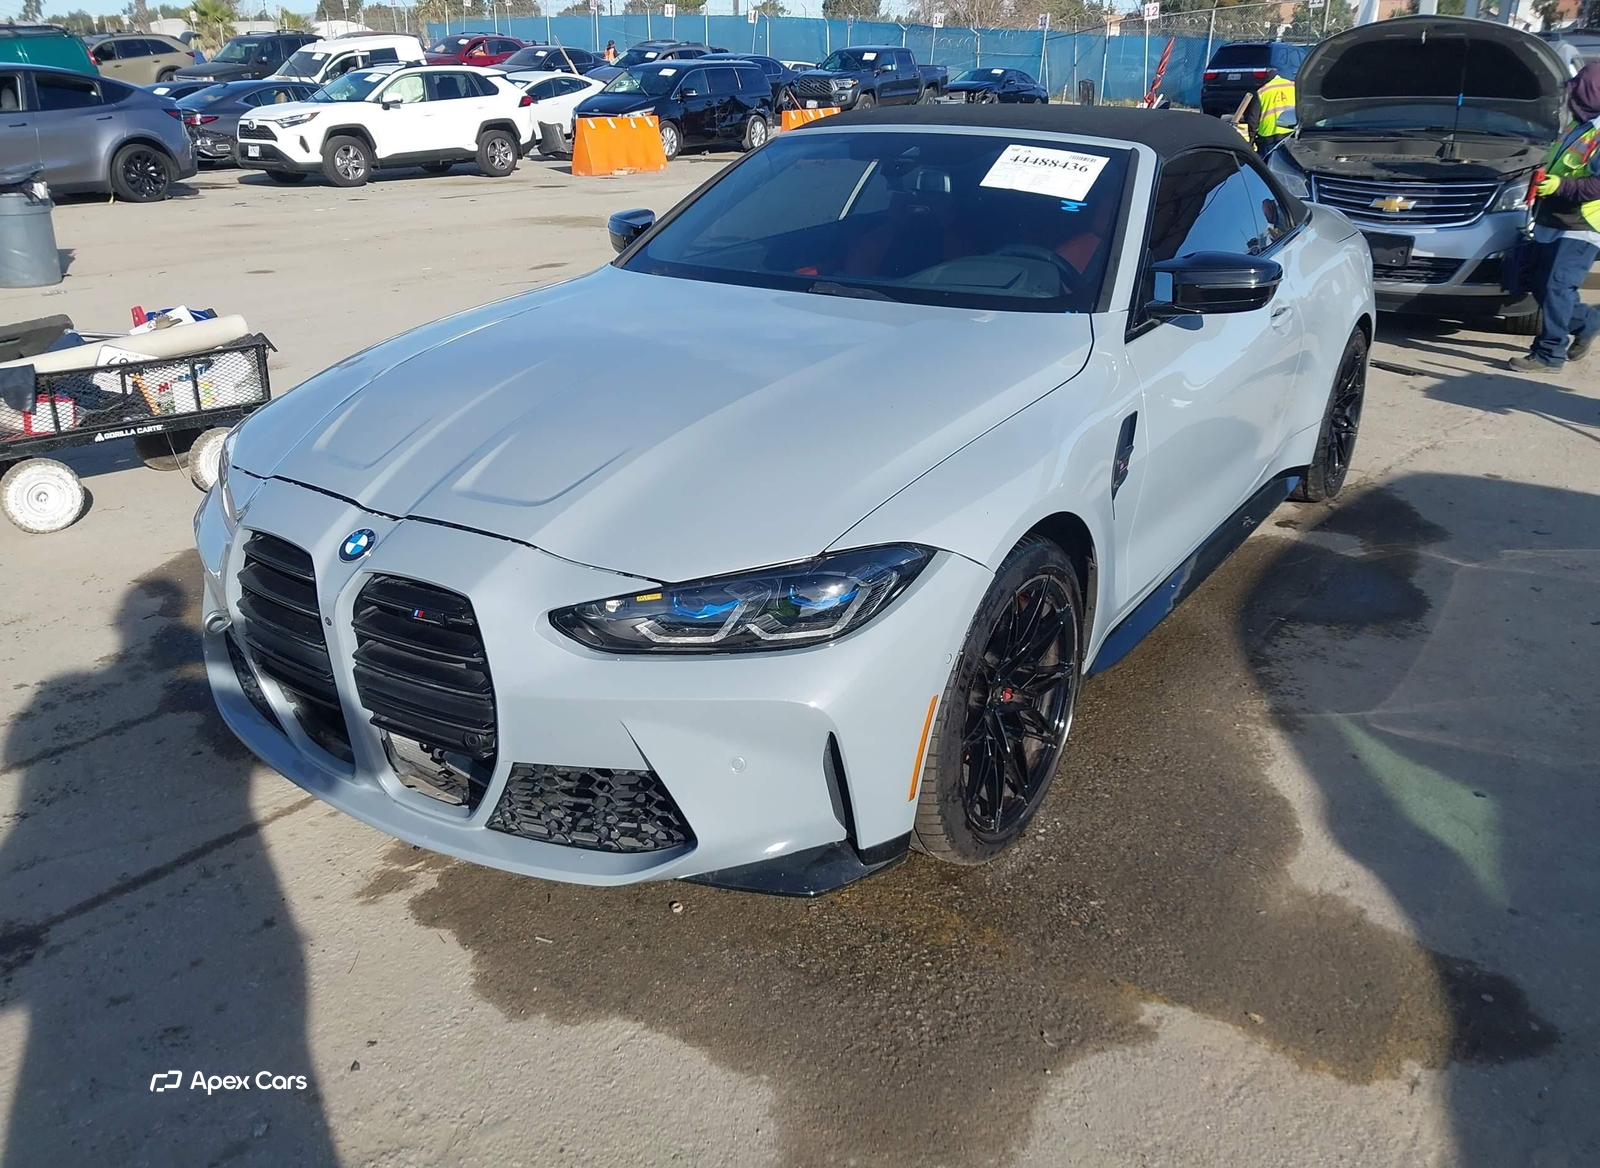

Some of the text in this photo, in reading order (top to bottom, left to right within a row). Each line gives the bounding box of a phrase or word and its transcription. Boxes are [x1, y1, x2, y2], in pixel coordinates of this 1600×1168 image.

[1146, 6, 1158, 17] 12
[934, 15, 943, 25] 14
[1009, 154, 1088, 173] 44488436
[104, 428, 136, 440] GORILLA
